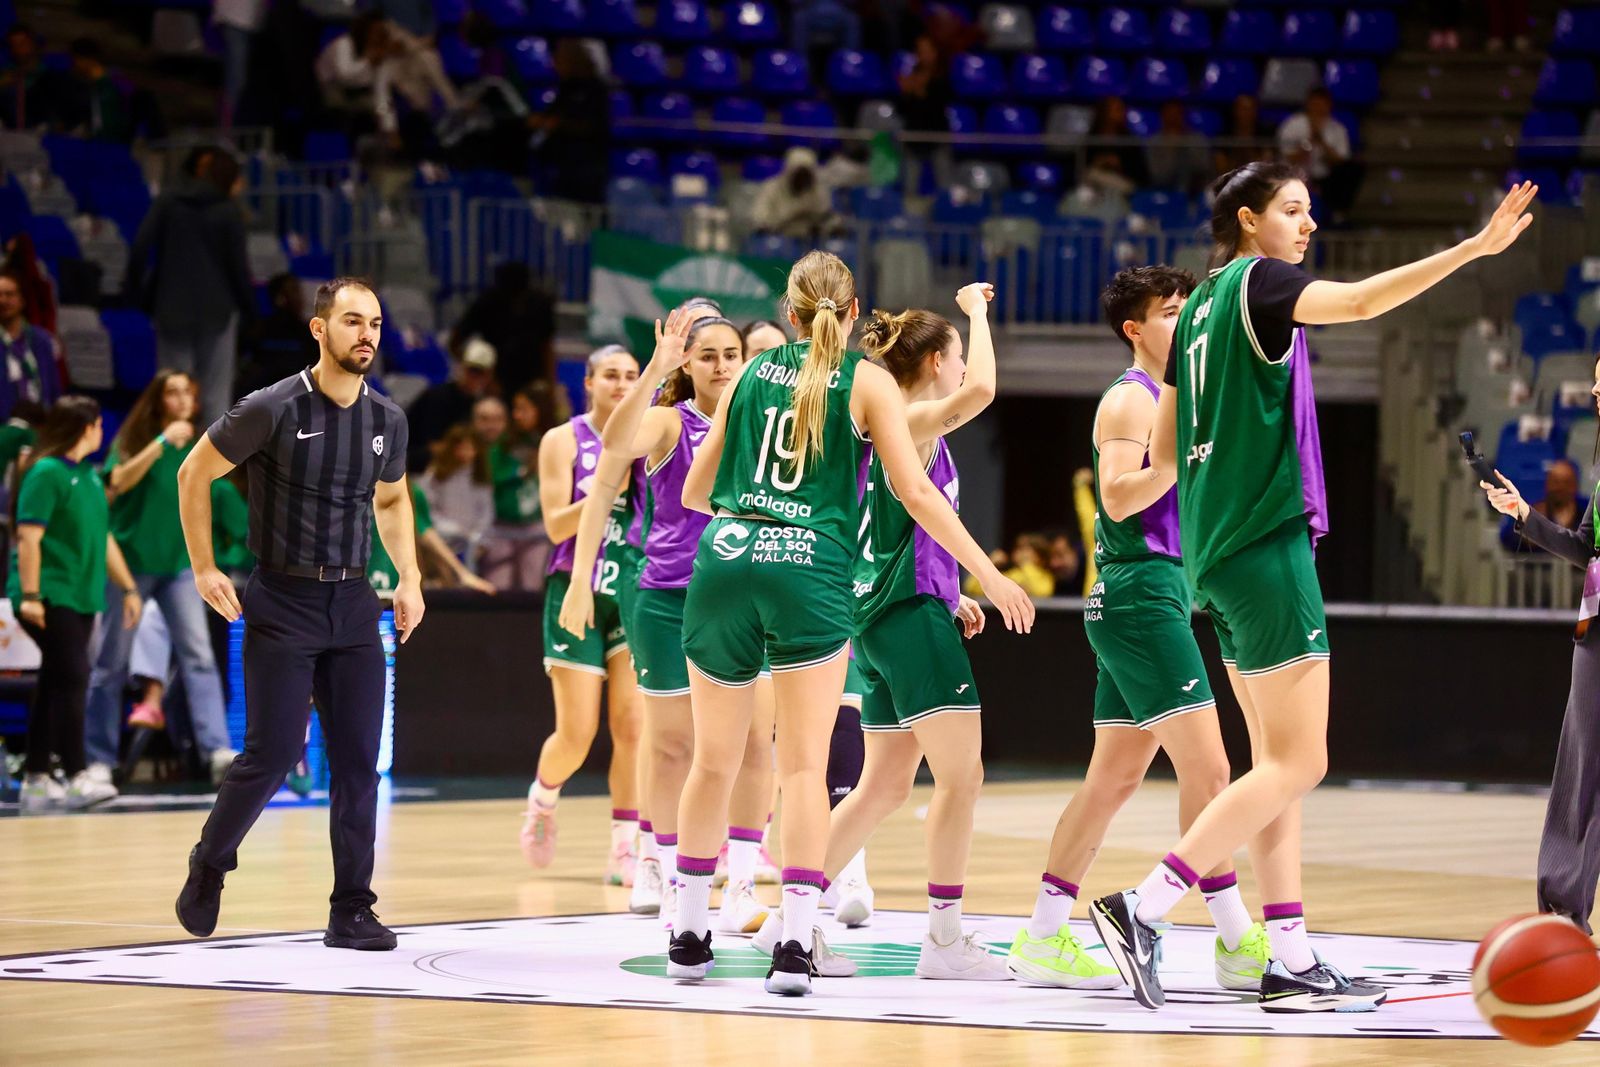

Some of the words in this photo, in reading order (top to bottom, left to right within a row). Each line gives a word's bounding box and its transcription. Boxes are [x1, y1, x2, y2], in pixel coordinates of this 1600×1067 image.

[1186, 332, 1208, 427] 17
[753, 406, 809, 492] 19
[753, 540, 782, 551] DEL
[785, 540, 815, 555] SOL
[758, 526, 817, 542] COSTA
[751, 550, 813, 567] MÁLAGA
[593, 558, 620, 596] 12
